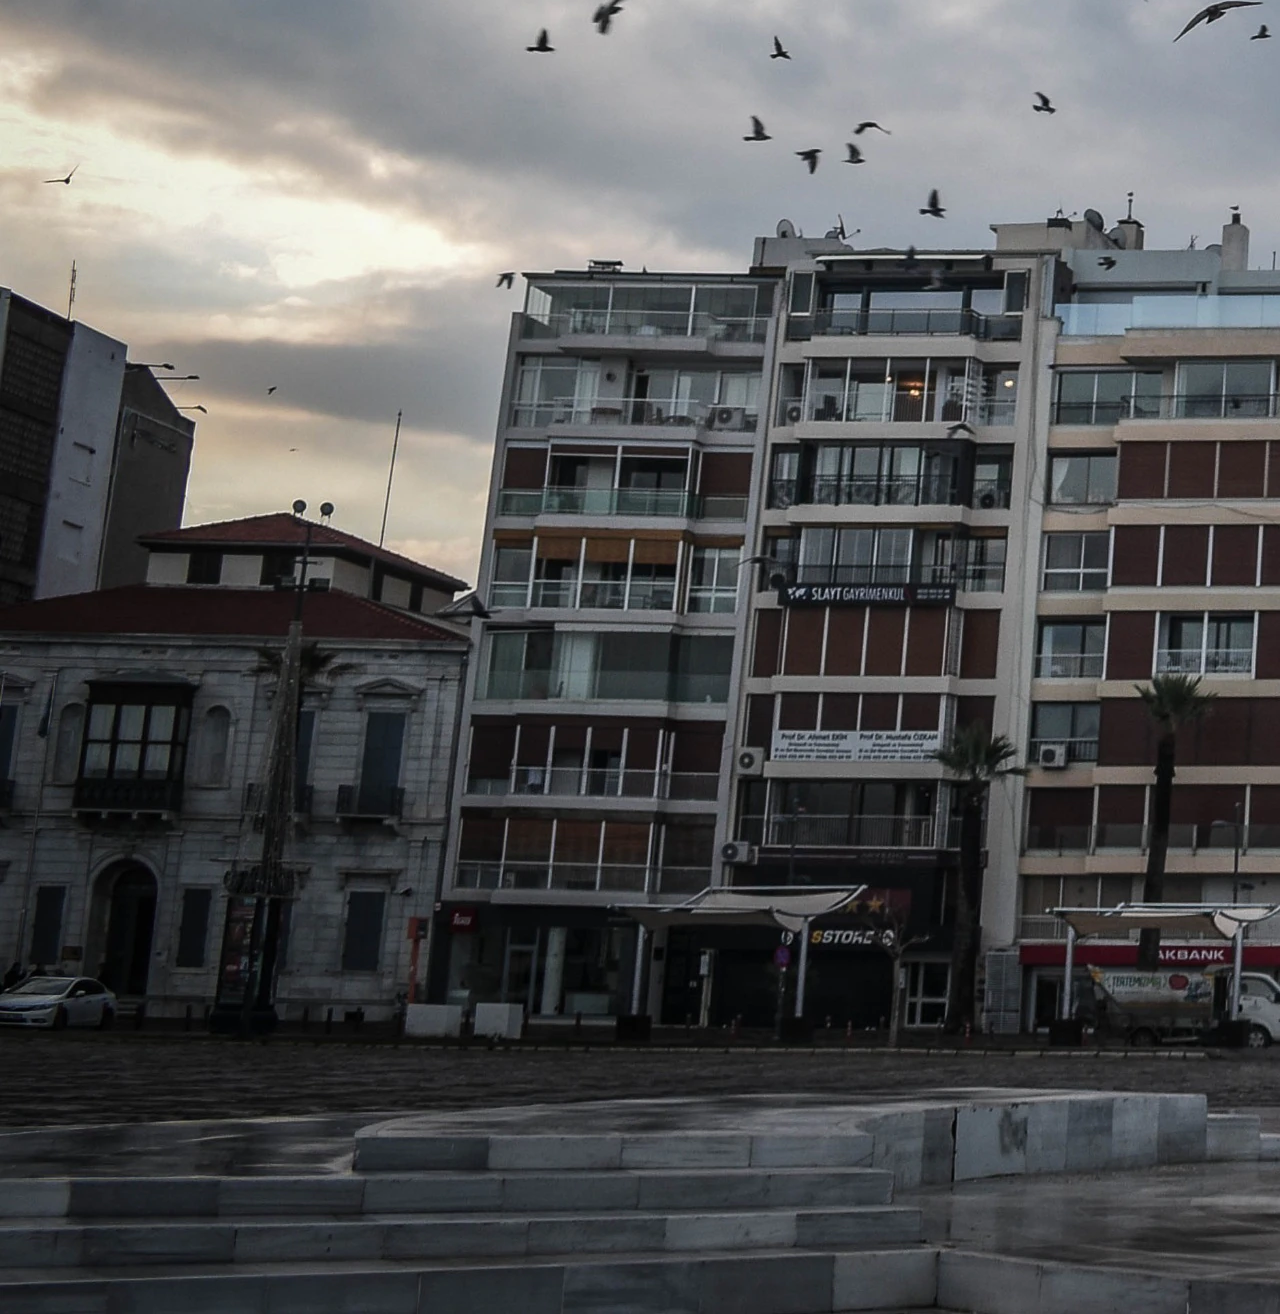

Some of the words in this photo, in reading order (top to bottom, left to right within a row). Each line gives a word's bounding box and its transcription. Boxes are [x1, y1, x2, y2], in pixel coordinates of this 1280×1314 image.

[812, 587, 843, 601] SLAYT
[843, 585, 905, 601] GAYRİMENKUL
[1158, 950, 1225, 961] AKBANK
